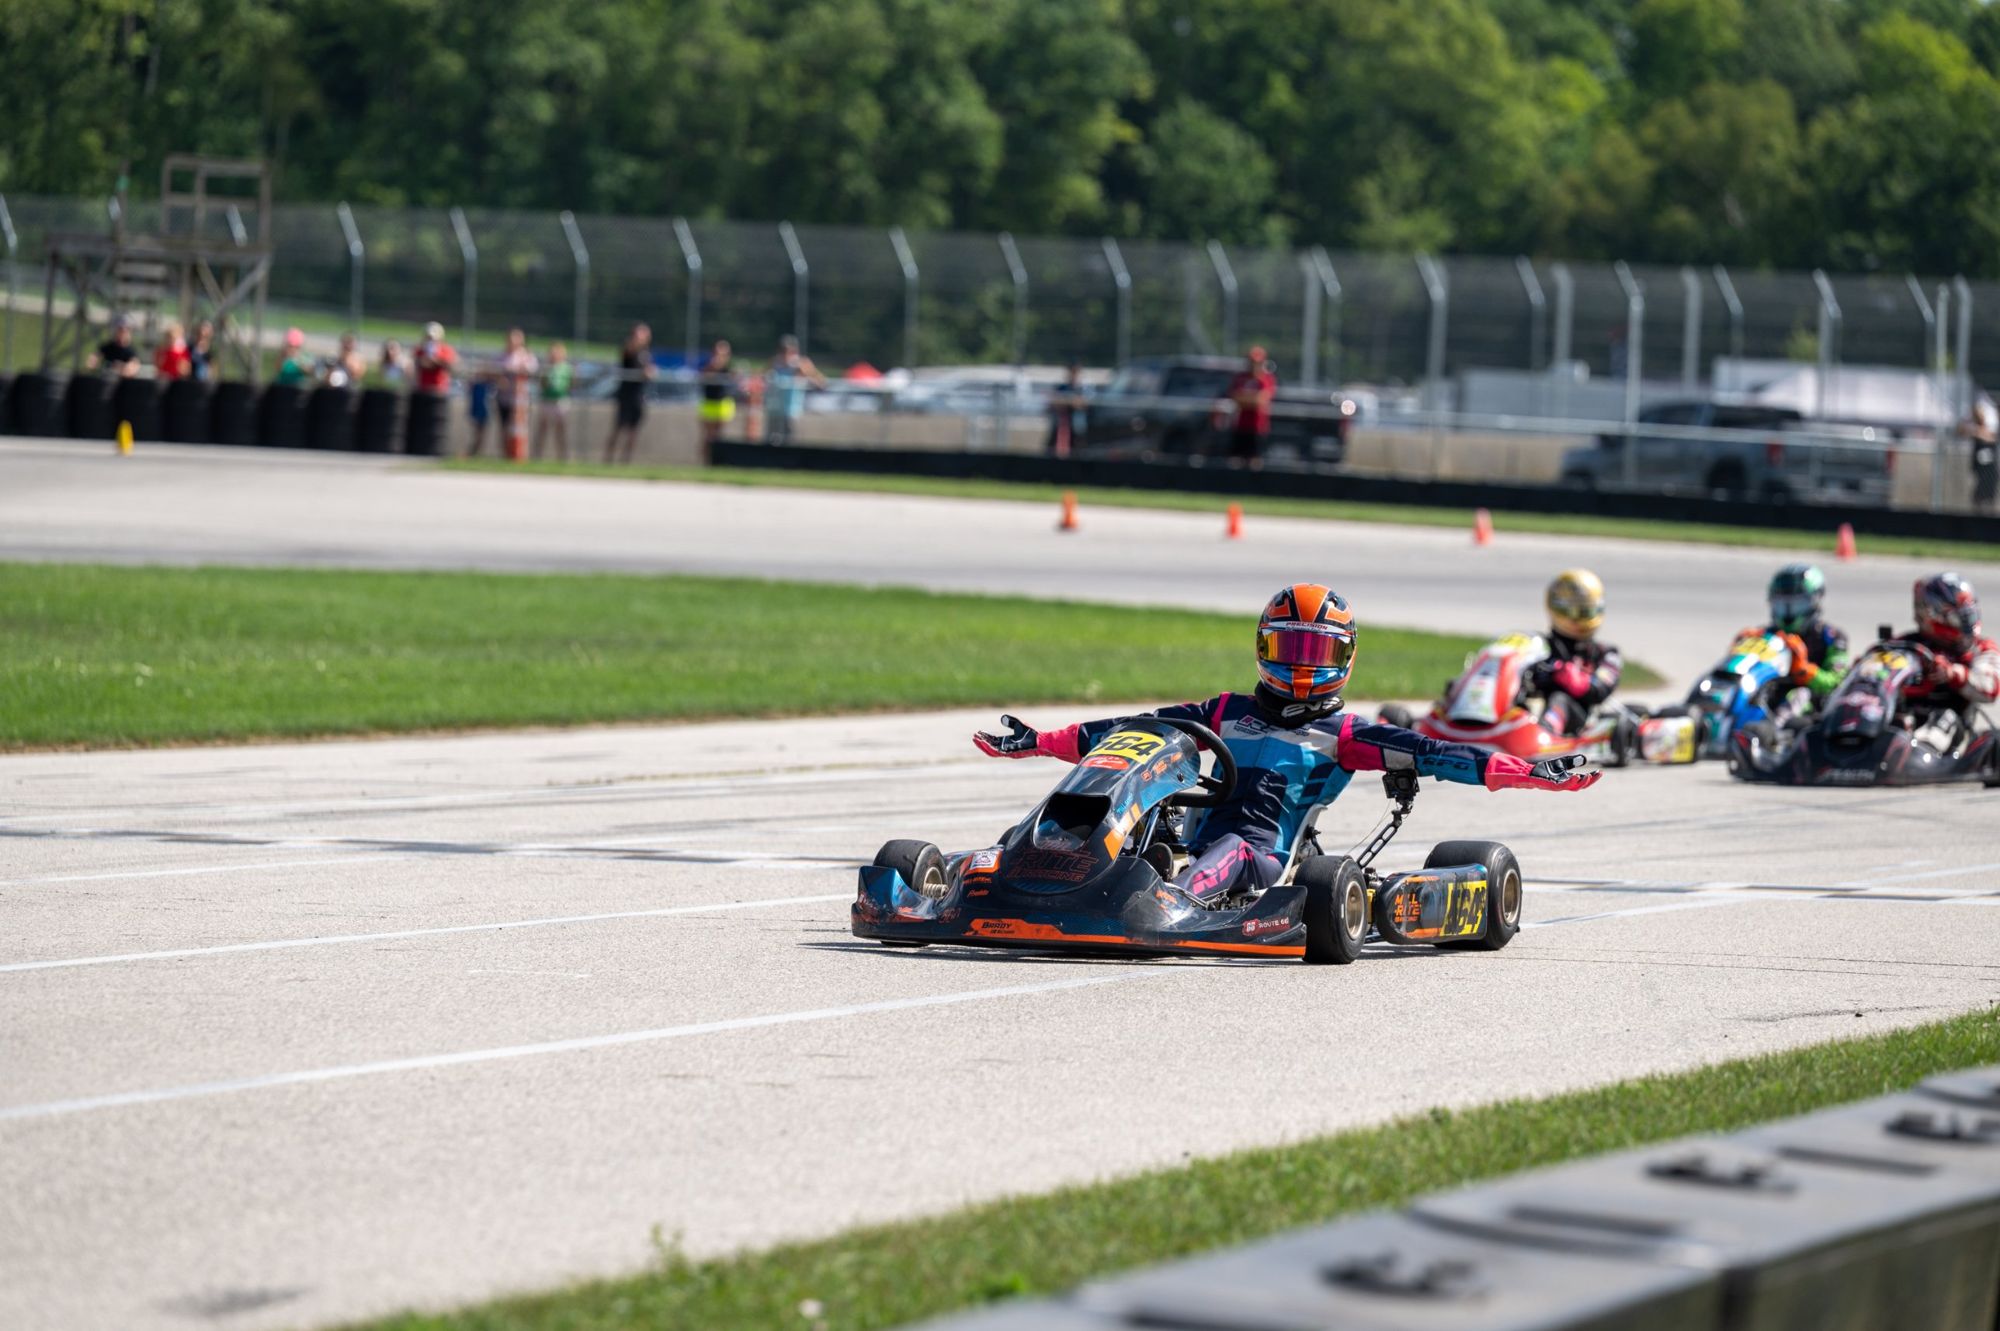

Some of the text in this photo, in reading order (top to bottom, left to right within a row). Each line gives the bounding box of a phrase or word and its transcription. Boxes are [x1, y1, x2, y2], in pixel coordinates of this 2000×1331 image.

[1286, 622, 1328, 630] PRECISION
[1281, 697, 1340, 717] EVS
[1394, 893, 1419, 905] MLL
[1258, 917, 1290, 929] ROUTE 66
